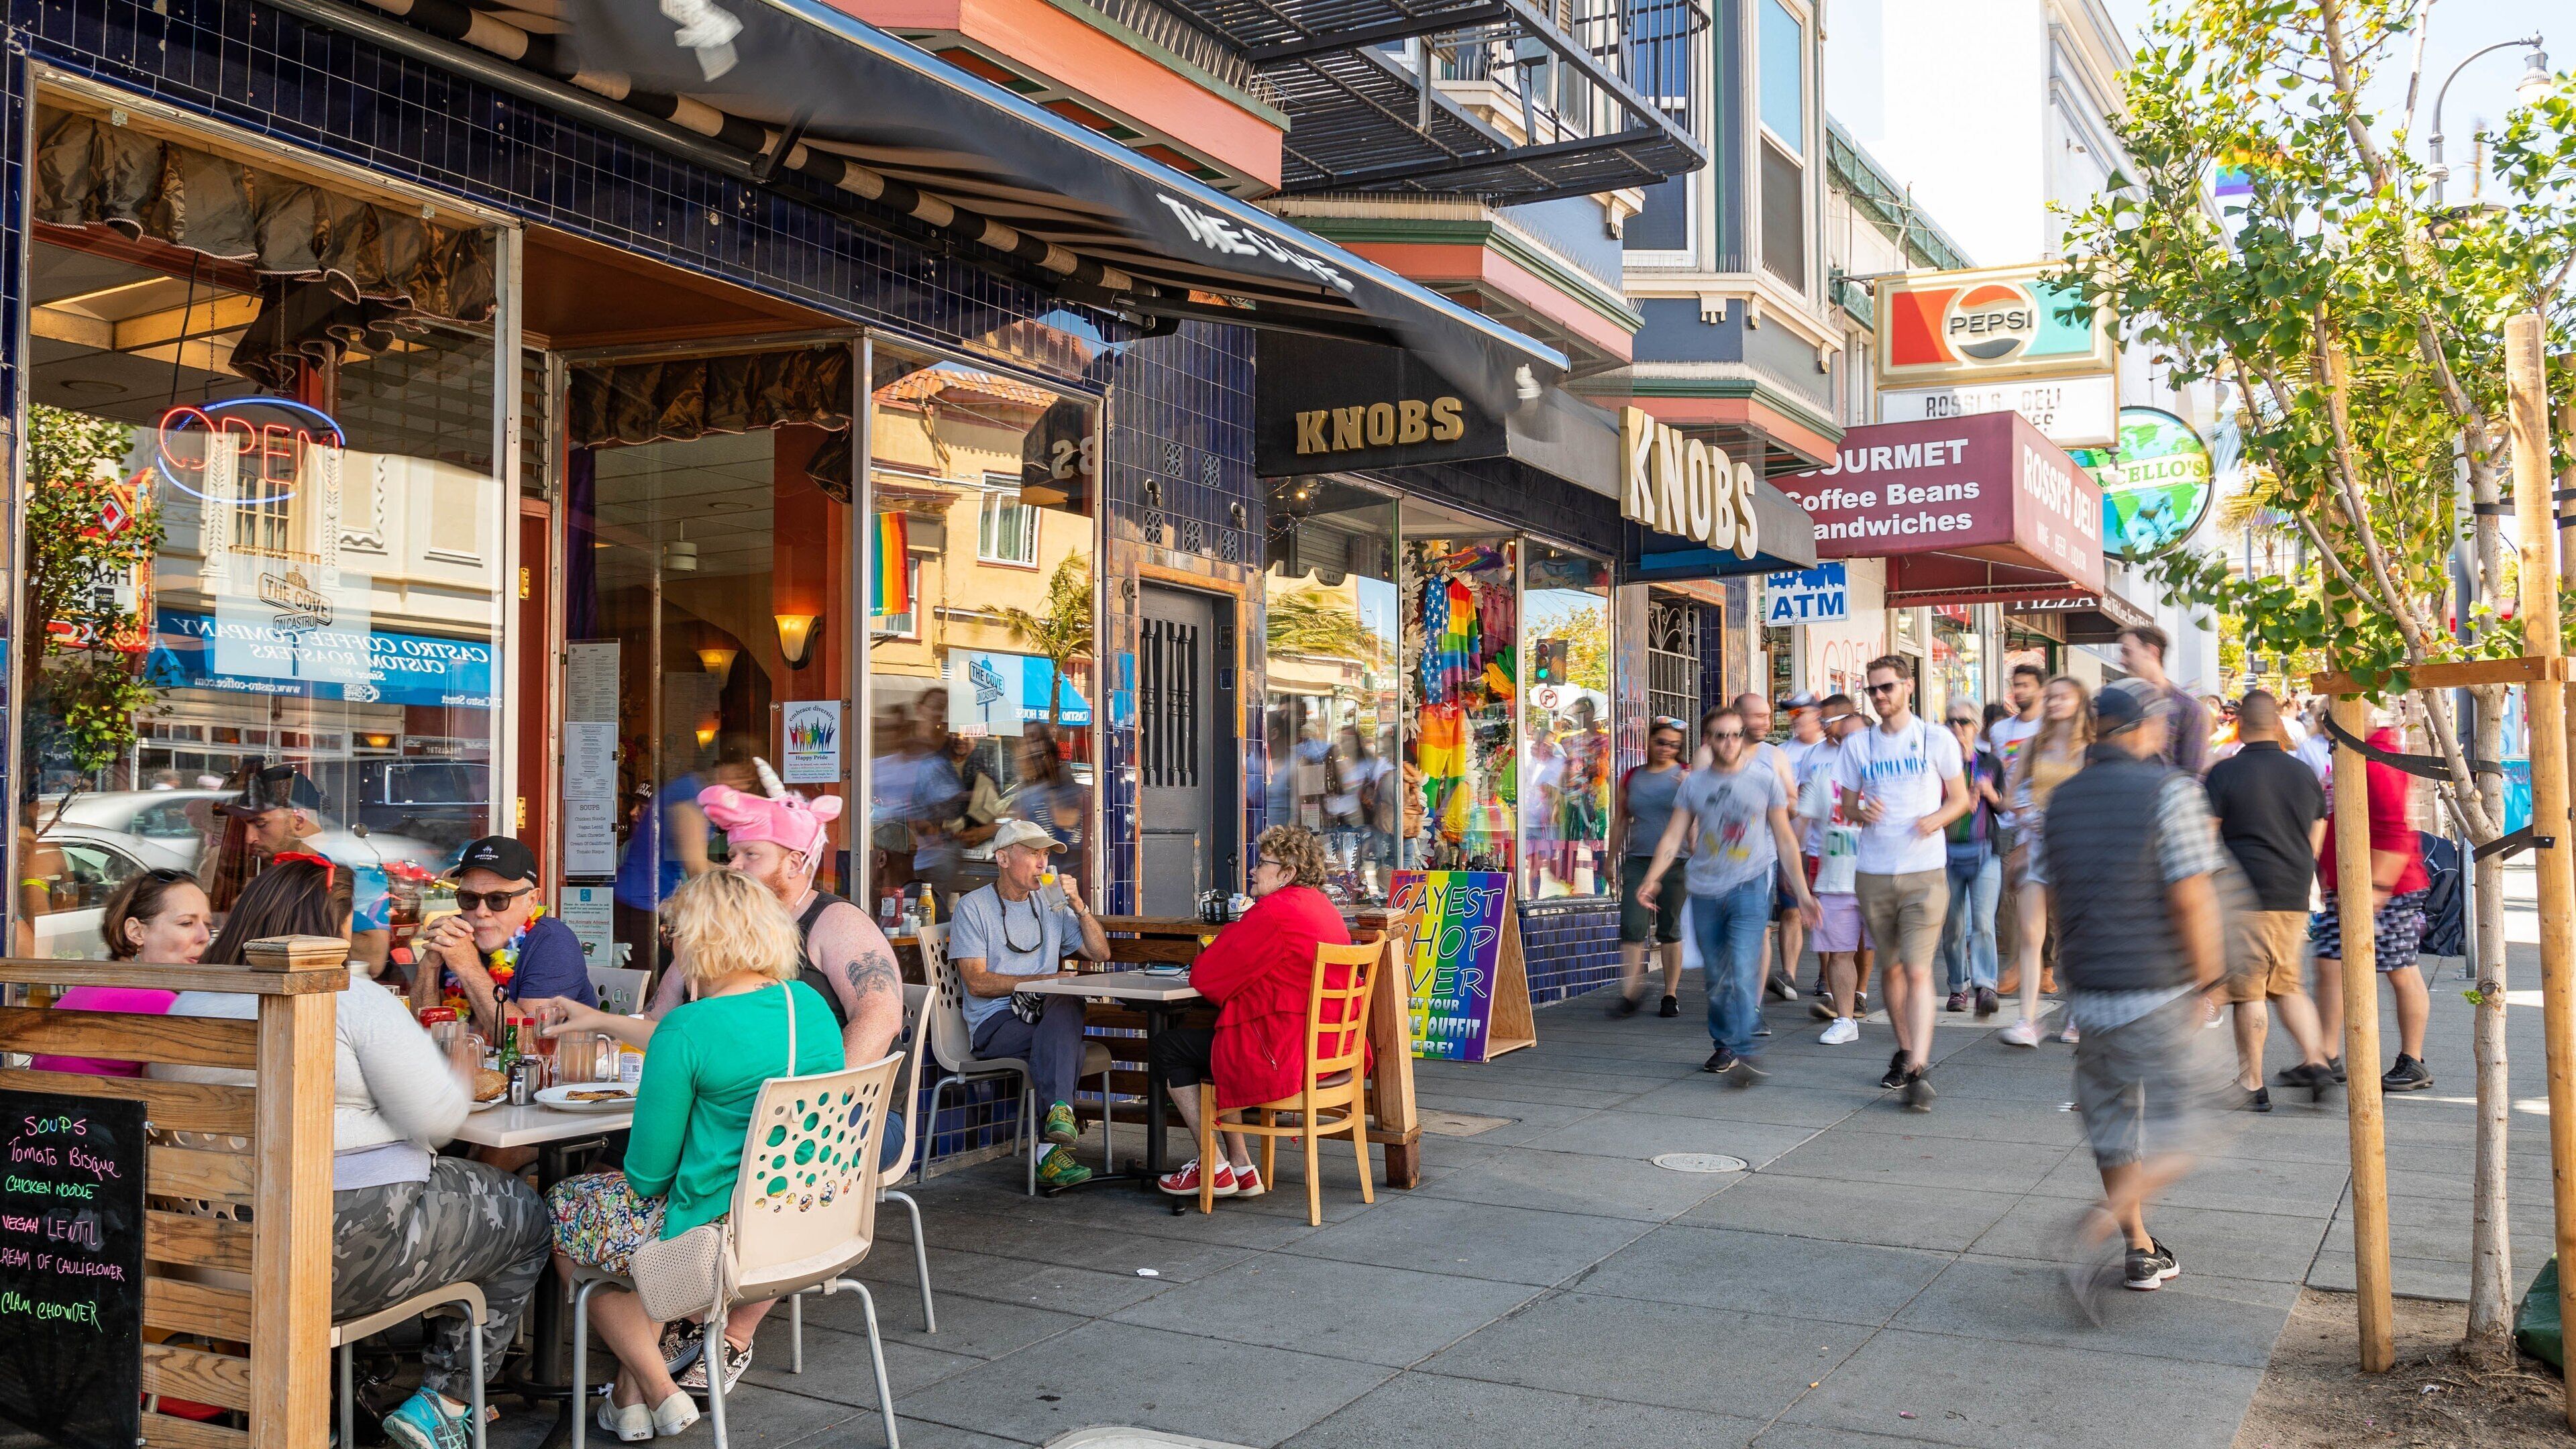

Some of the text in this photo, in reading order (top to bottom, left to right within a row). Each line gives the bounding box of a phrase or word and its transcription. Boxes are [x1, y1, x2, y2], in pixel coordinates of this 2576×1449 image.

[1949, 309, 2032, 334] PEPSI
[2022, 388, 2061, 411] DELI
[1295, 396, 1464, 454] KNOBS
[160, 407, 339, 492] OPEN
[1796, 439, 1968, 477] OURMET
[1619, 405, 1758, 560] KNOBS
[1887, 482, 1980, 505] Beans
[2024, 443, 2096, 541] ROSSI'S DELI
[1815, 511, 1972, 540] andwiches
[2037, 520, 2086, 572] WINE BEER LIQUOR
[266, 578, 327, 617] THE COVE
[1771, 592, 1844, 620] ATM
[275, 614, 315, 631] ON CASTRO
[972, 665, 1002, 691] THE COVE
[983, 689, 997, 702] CASTRO
[789, 705, 835, 722] embrace diversity
[1395, 874, 1426, 885] THE
[1391, 881, 1502, 918] GAYEST
[1403, 922, 1496, 961] HOP
[1405, 964, 1487, 998] VER
[1427, 998, 1460, 1011] YOUR
[1428, 1016, 1481, 1039] OUTFIT
[1411, 1040, 1454, 1054] ERE!
[24, 1116, 87, 1136] SOUPS
[8, 1136, 121, 1181] Tomato Bisque
[6, 1175, 99, 1199] CHICKEN NOODLE
[2, 1216, 97, 1245] VEGAN LENTIL
[0, 1248, 31, 1270] REAM
[38, 1254, 52, 1269] OF
[2, 1291, 102, 1333] CLAM CHOWDER
